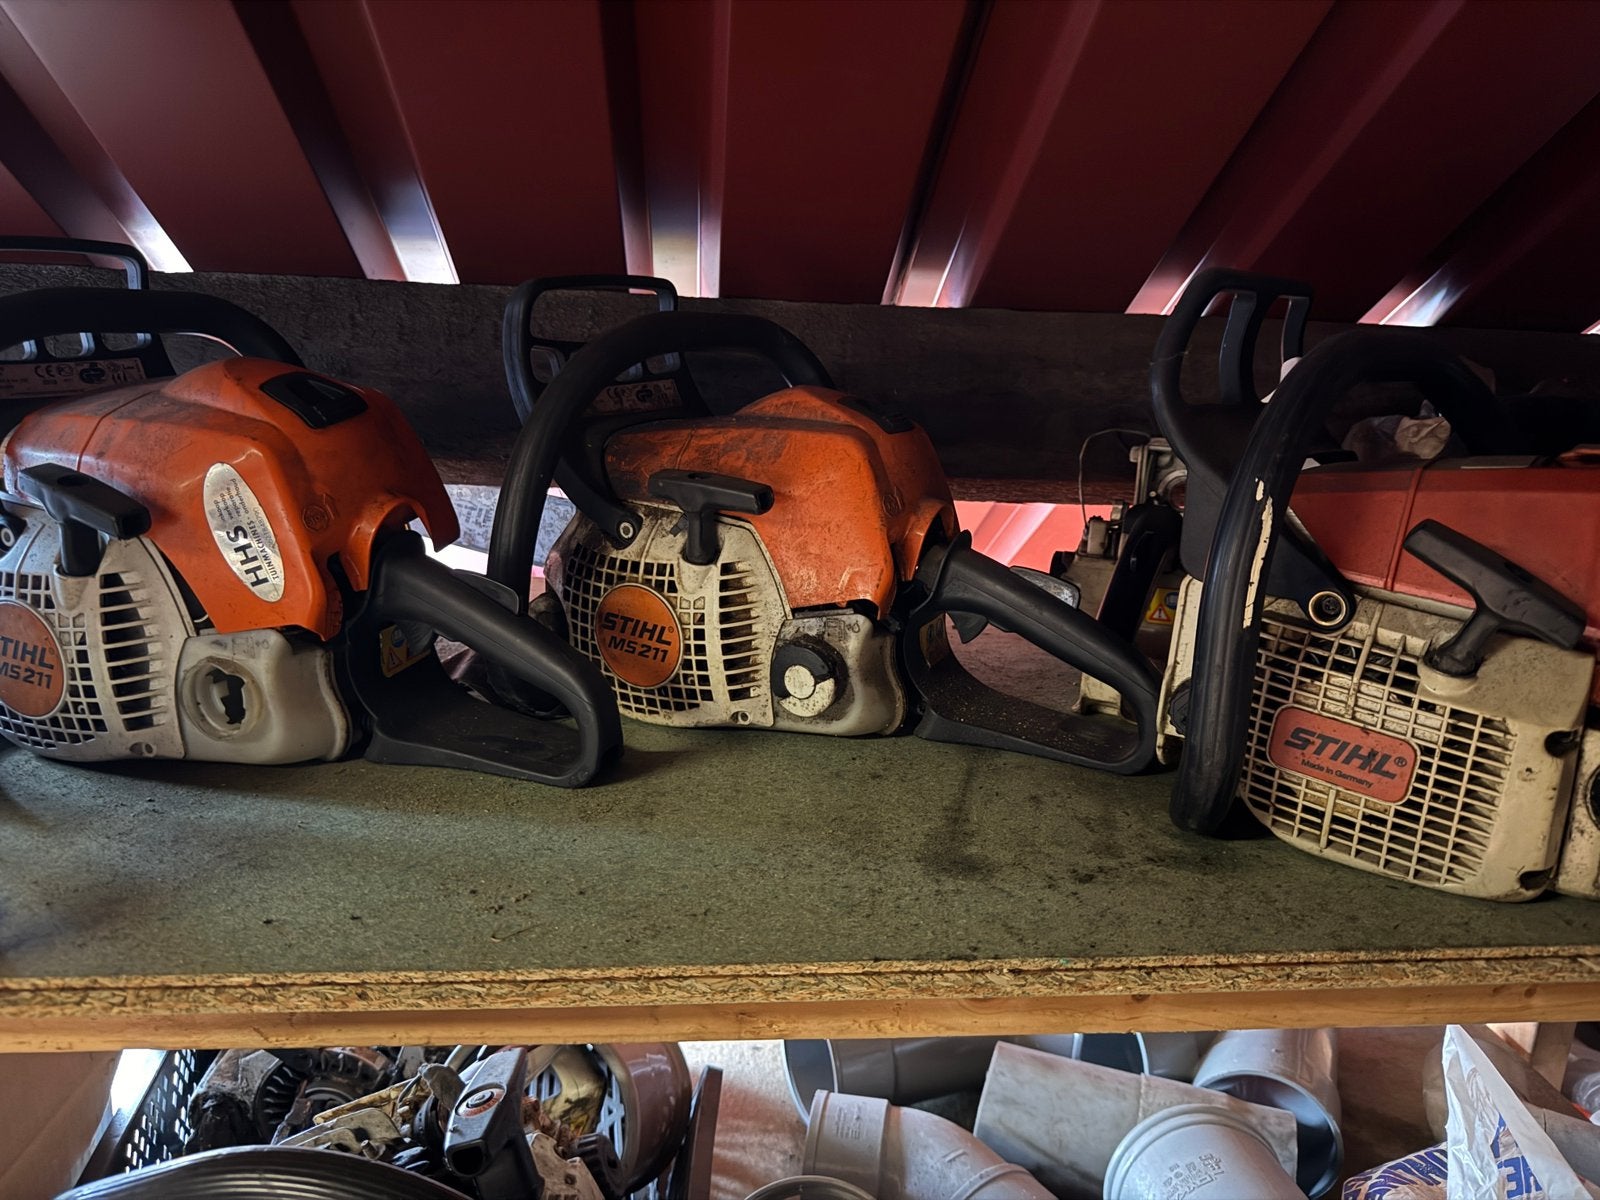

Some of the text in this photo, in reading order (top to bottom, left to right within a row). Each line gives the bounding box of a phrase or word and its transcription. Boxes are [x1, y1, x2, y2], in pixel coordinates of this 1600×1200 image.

[226, 525, 270, 587] HHS
[249, 520, 279, 580] TUINMACHINES
[601, 612, 672, 646] STIHL
[0, 636, 54, 670] TIHL
[1301, 758, 1325, 773] Made
[1335, 769, 1374, 789] Germany
